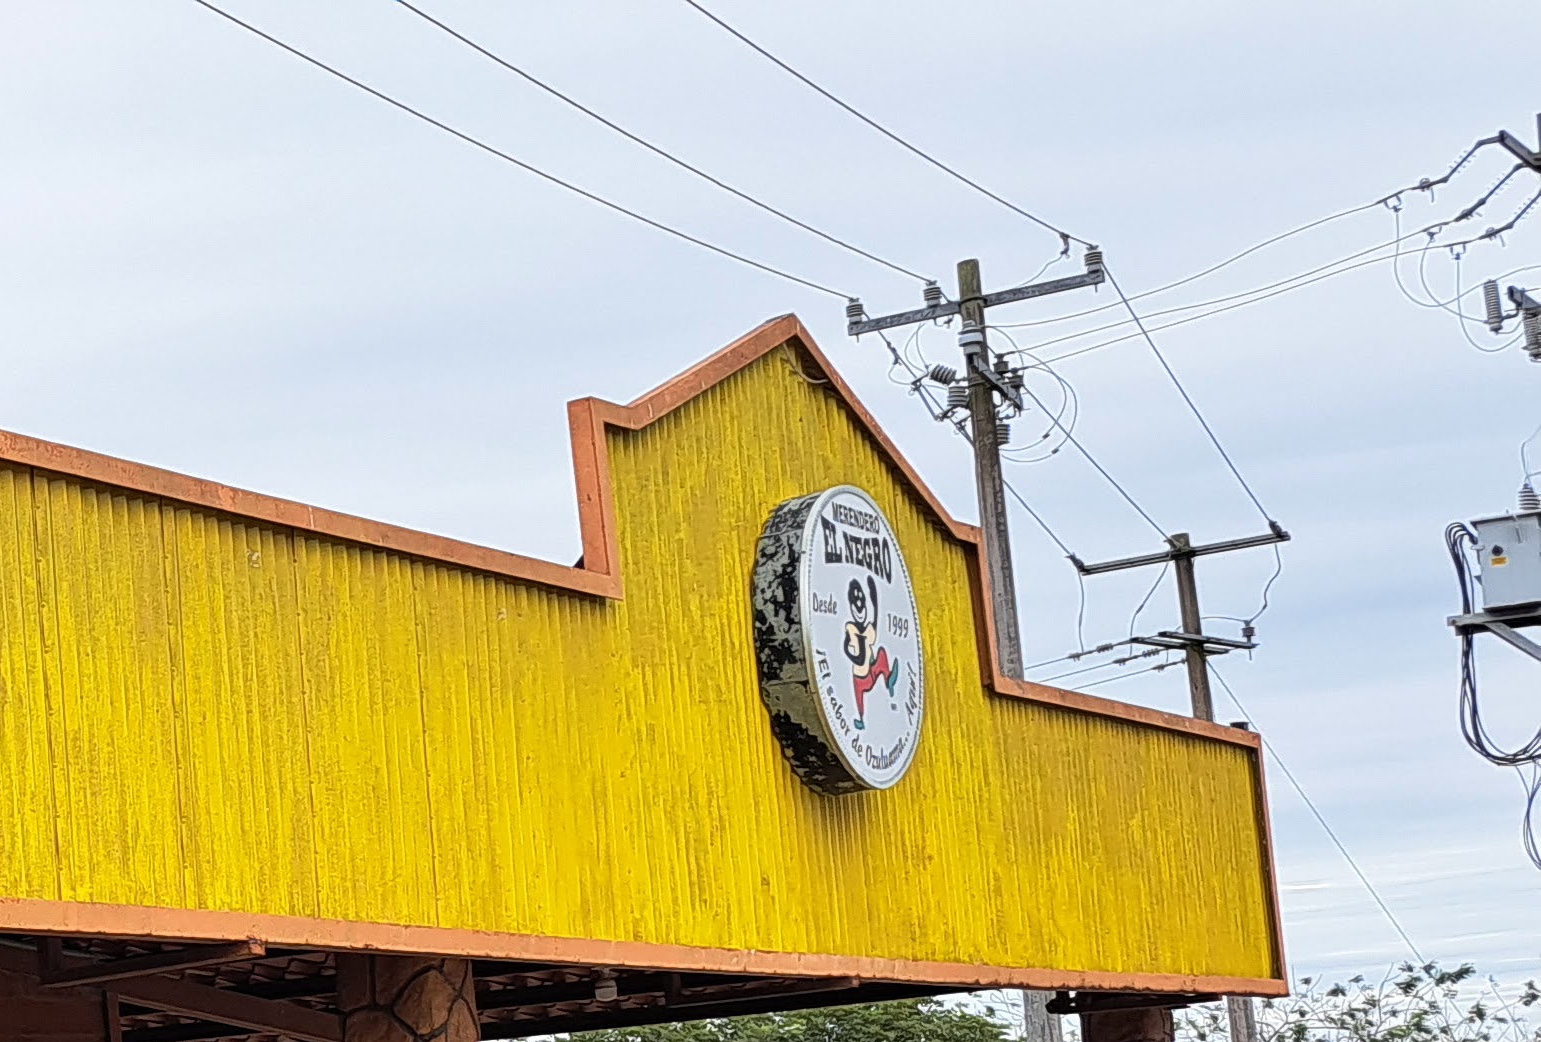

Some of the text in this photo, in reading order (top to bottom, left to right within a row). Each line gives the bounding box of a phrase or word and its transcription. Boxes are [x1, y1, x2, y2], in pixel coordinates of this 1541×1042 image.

[831, 501, 880, 535] MERENDERO
[821, 514, 892, 584] EL NEGRO
[813, 592, 838, 615] Desde
[888, 613, 909, 638] 1999
[852, 734, 863, 758] de
